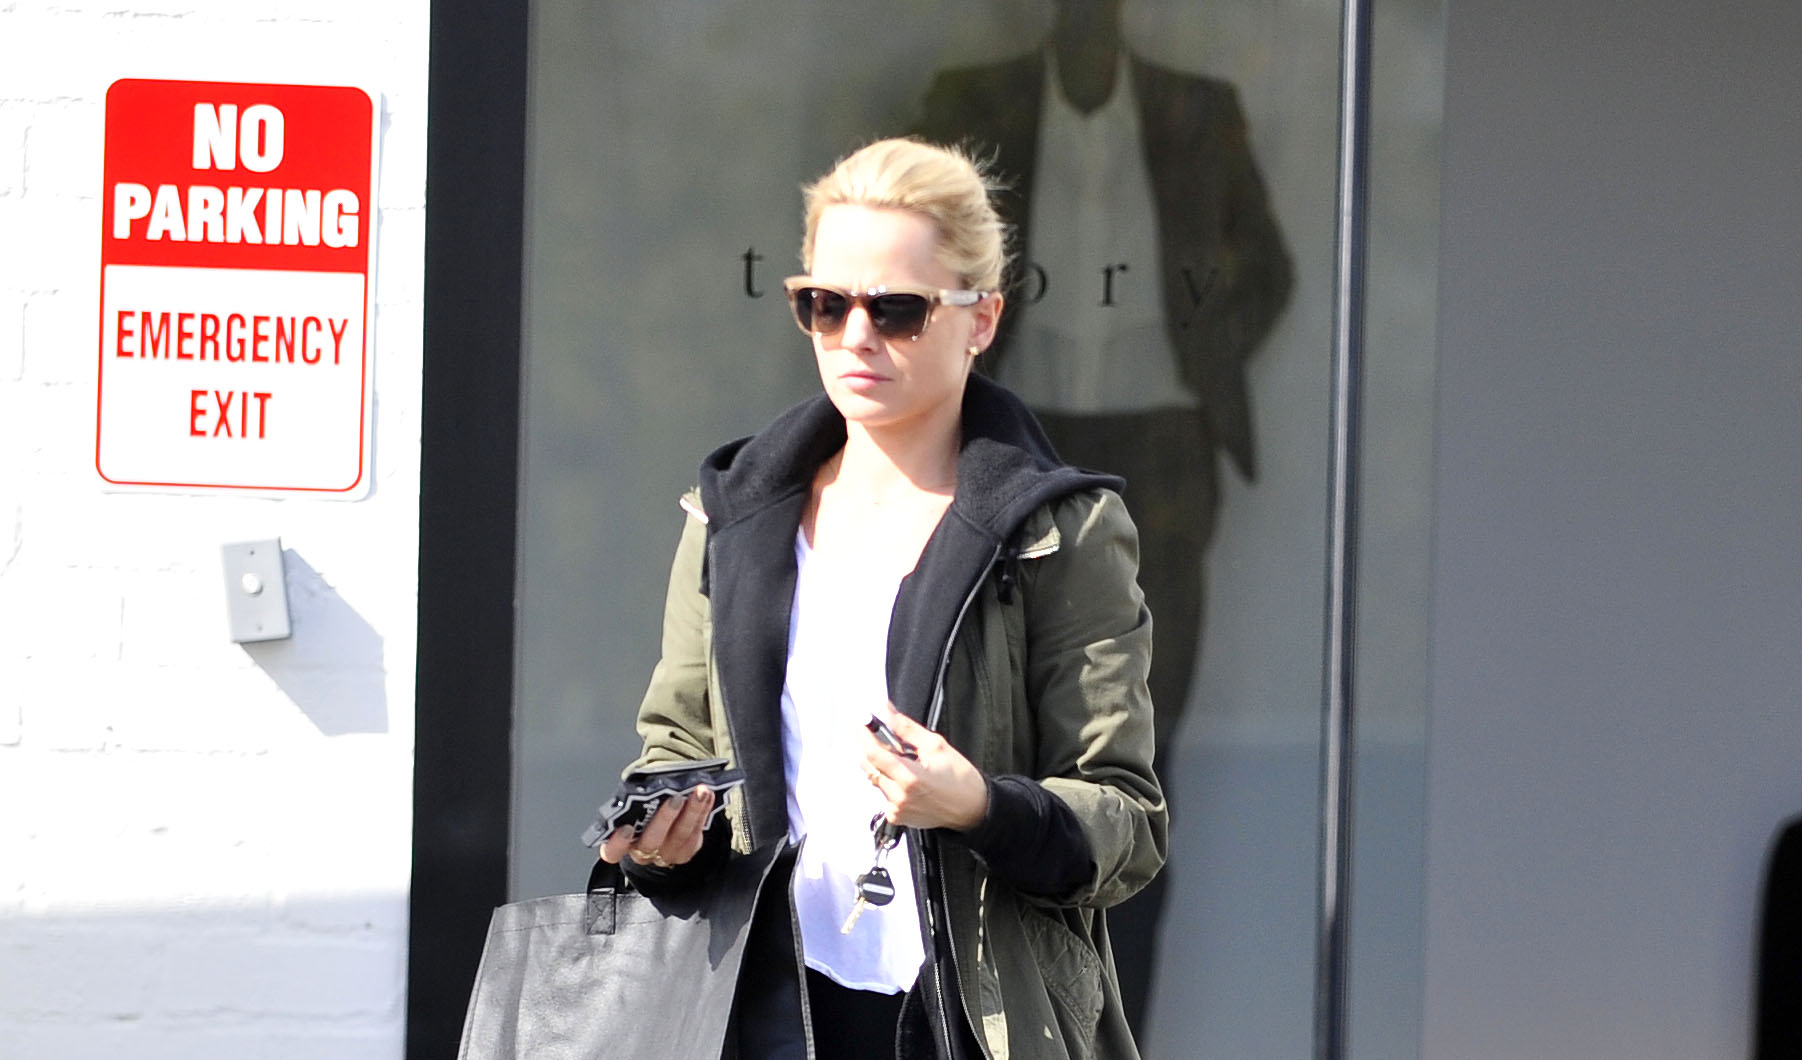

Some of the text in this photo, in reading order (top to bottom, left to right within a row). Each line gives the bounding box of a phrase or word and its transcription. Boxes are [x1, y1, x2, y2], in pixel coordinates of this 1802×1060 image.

[193, 104, 285, 172] NO
[113, 182, 360, 248] PARKING
[116, 310, 349, 366] EMERGENCY
[189, 389, 273, 440] EXIT
